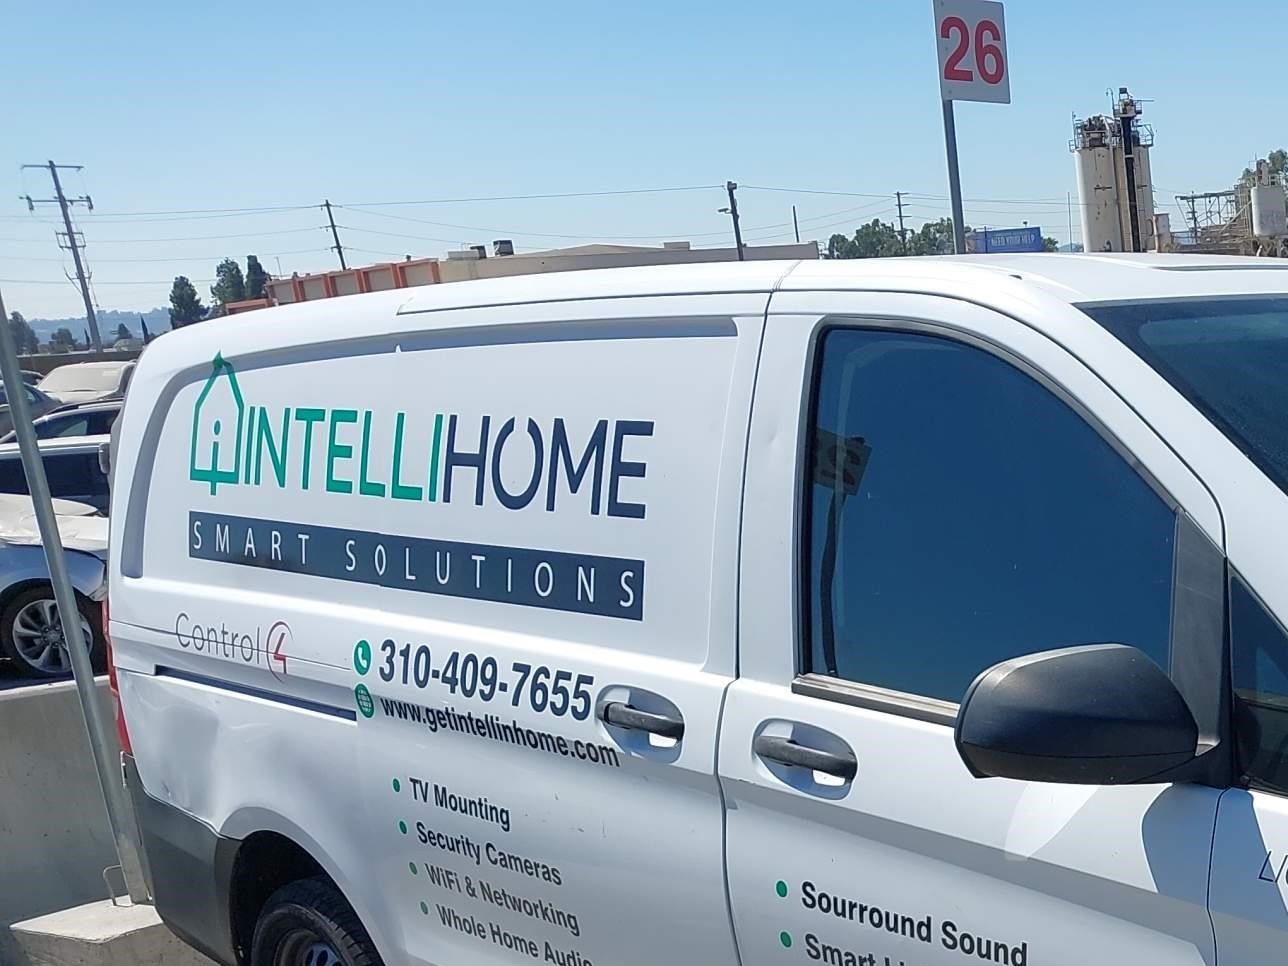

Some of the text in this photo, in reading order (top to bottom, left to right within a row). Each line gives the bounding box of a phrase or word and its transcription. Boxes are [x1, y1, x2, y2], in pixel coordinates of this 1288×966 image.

[940, 16, 1004, 85] 26
[244, 405, 655, 519] INTELLIHOME
[193, 520, 635, 608] SMART SOLUTIONS
[378, 638, 595, 722] 310-409-7655
[409, 777, 512, 832] TV Mounting
[416, 822, 562, 886] Security Cameras
[424, 863, 580, 937] WiFi & Networking
[436, 903, 487, 940] Whole
[489, 922, 539, 958] Home
[801, 880, 932, 943] Sourround
